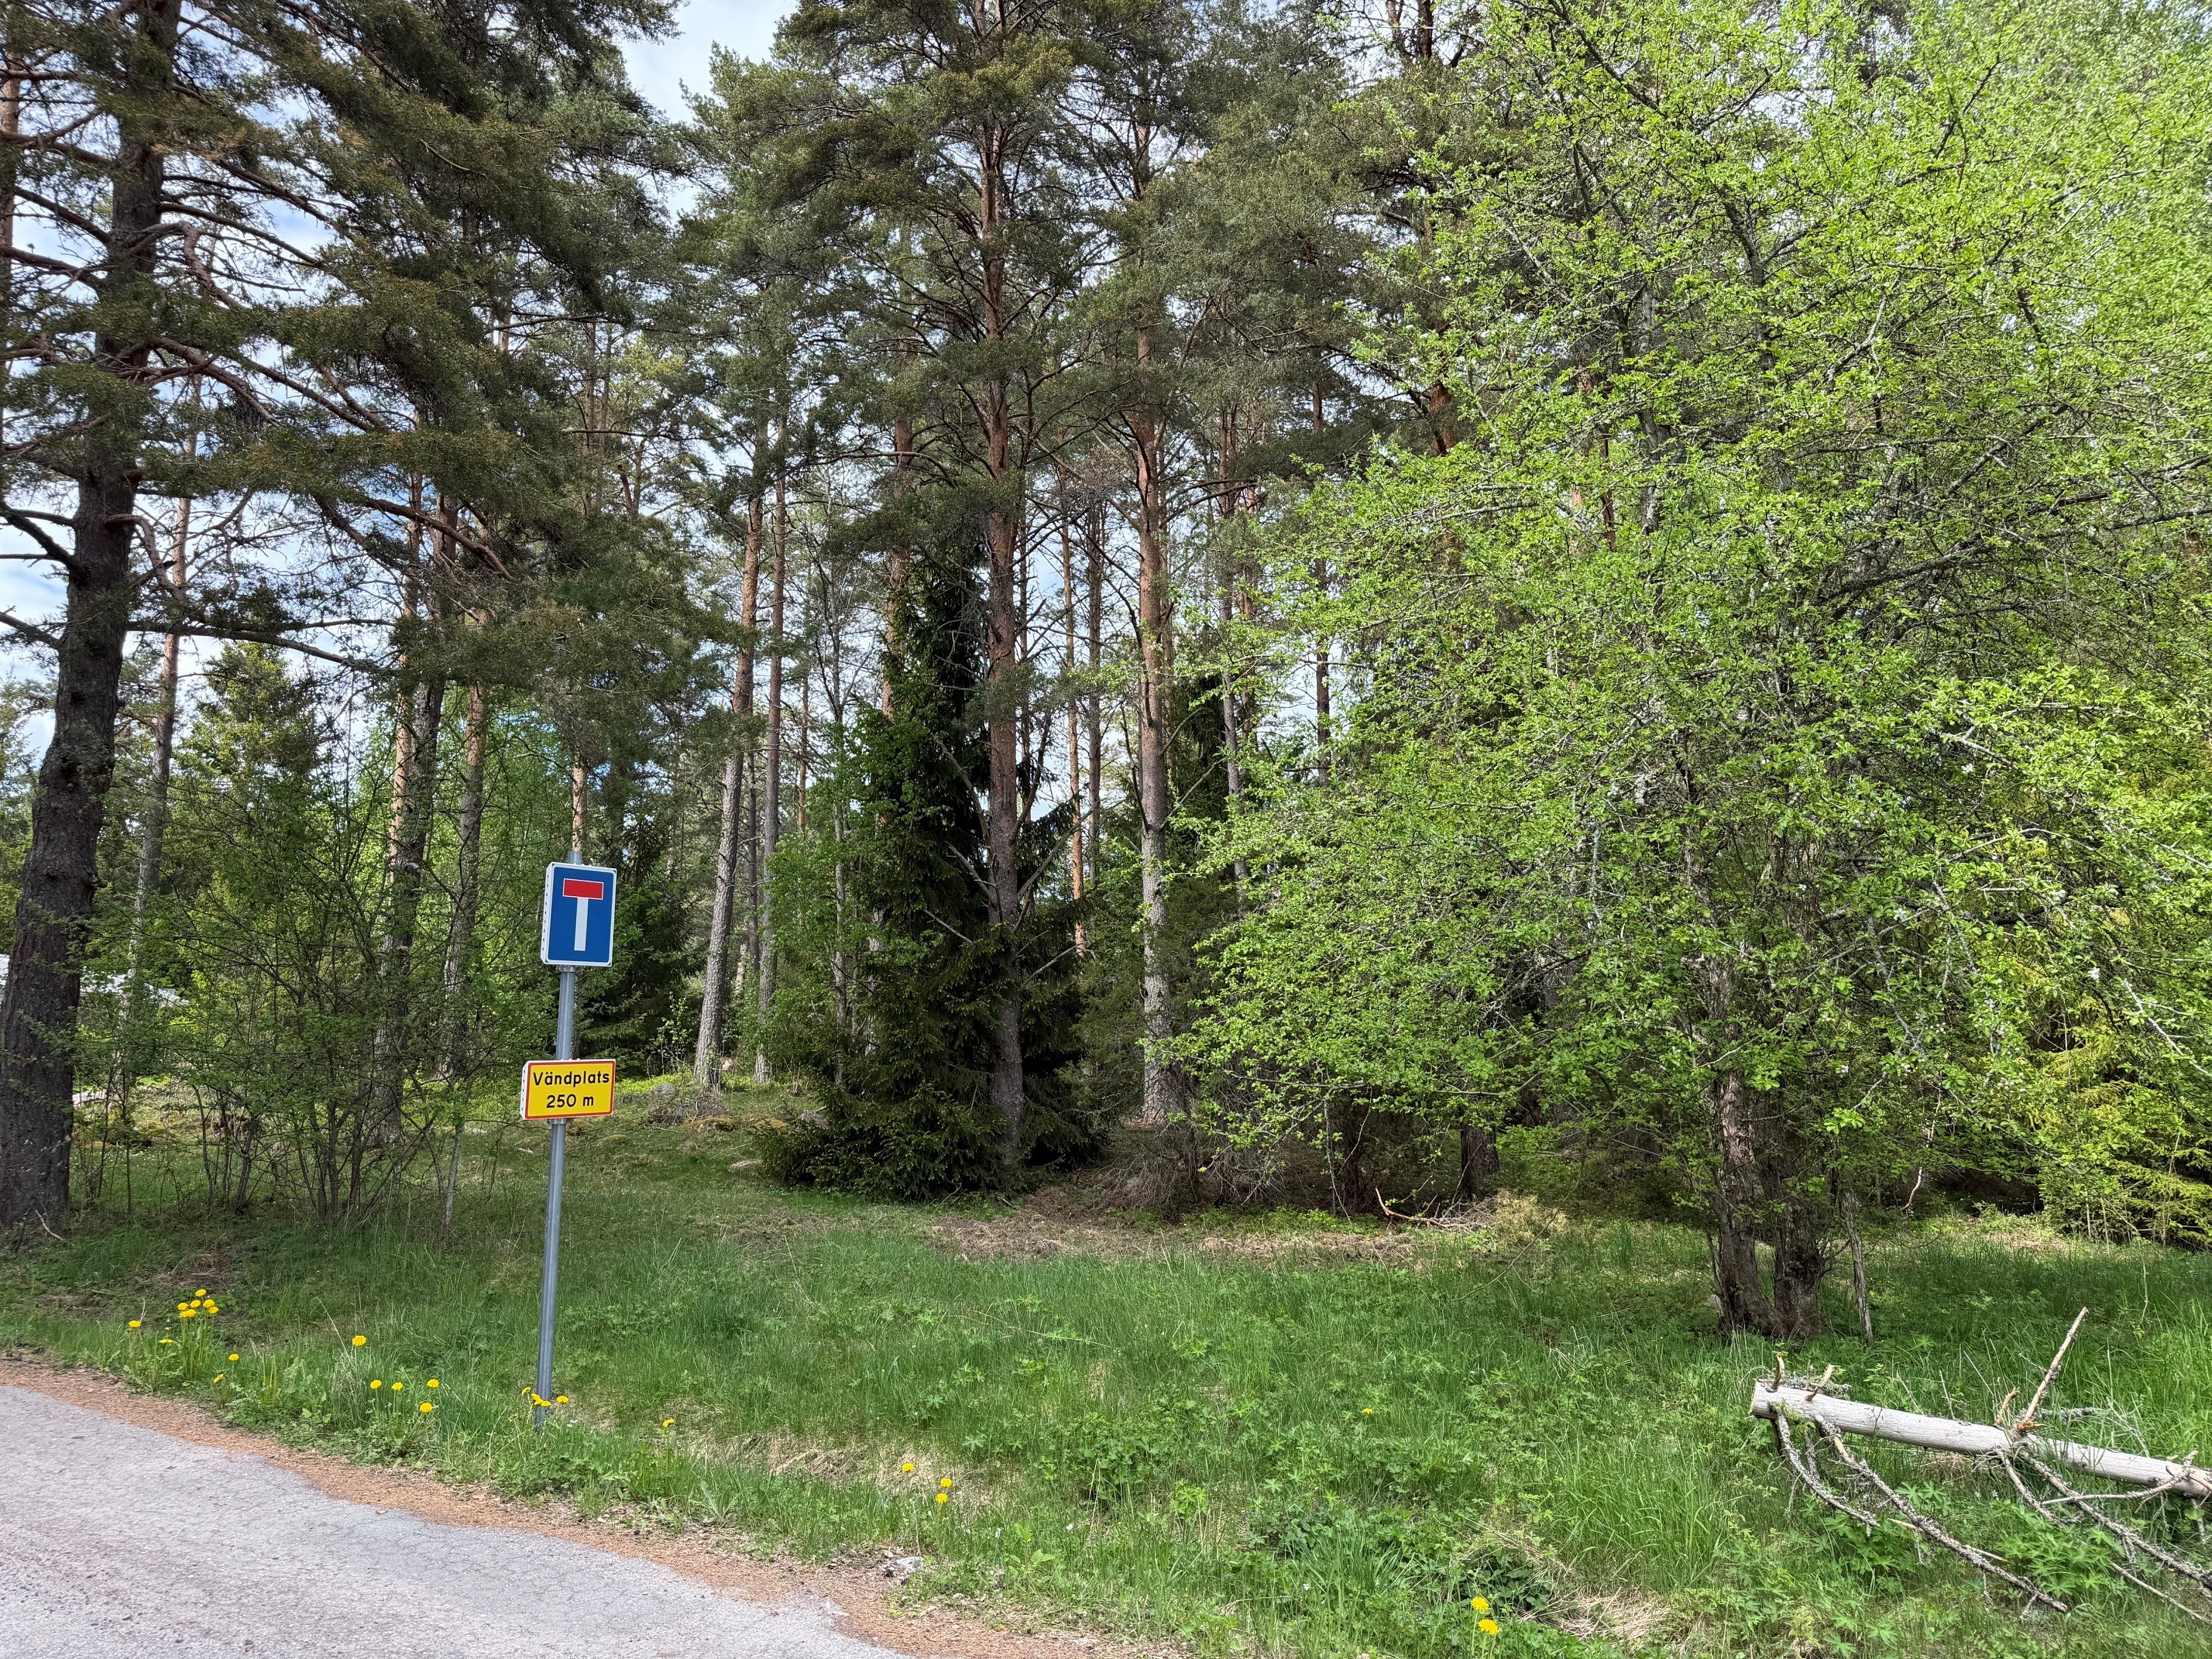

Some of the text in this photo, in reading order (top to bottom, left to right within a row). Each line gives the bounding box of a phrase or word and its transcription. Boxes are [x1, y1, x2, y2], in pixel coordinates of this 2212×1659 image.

[533, 1070, 610, 1087] Vändplats
[546, 1094, 594, 1108] 250 m
